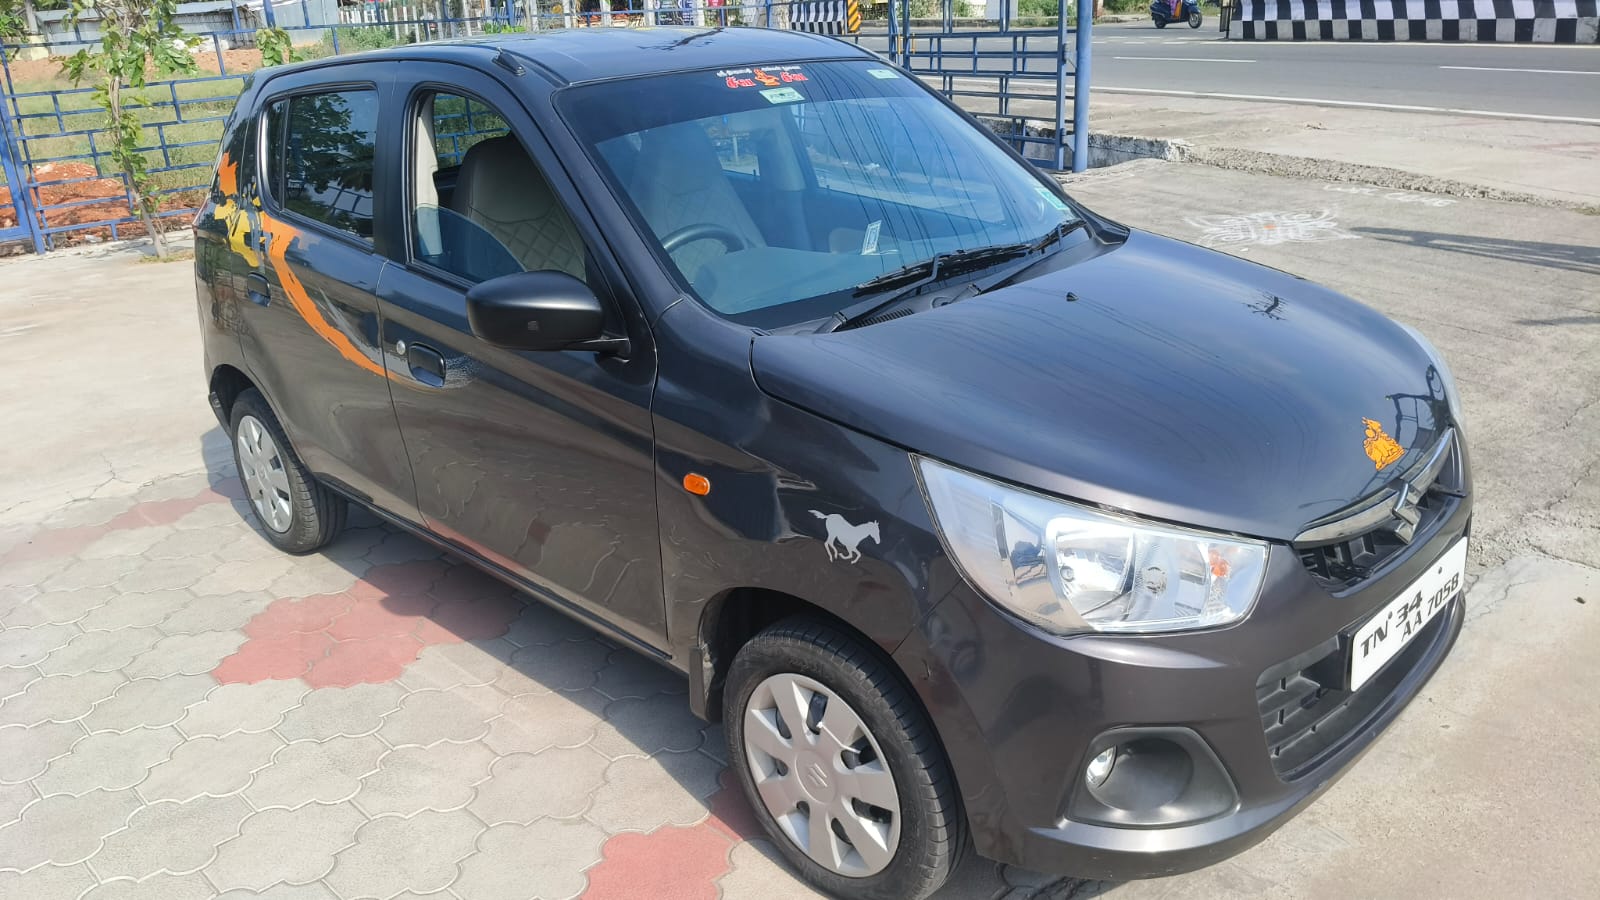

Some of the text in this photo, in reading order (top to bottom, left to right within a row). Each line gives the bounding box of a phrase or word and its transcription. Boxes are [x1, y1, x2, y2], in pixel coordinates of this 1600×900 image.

[1361, 590, 1422, 658] TN 34
[1401, 572, 1459, 642] AA 7058
